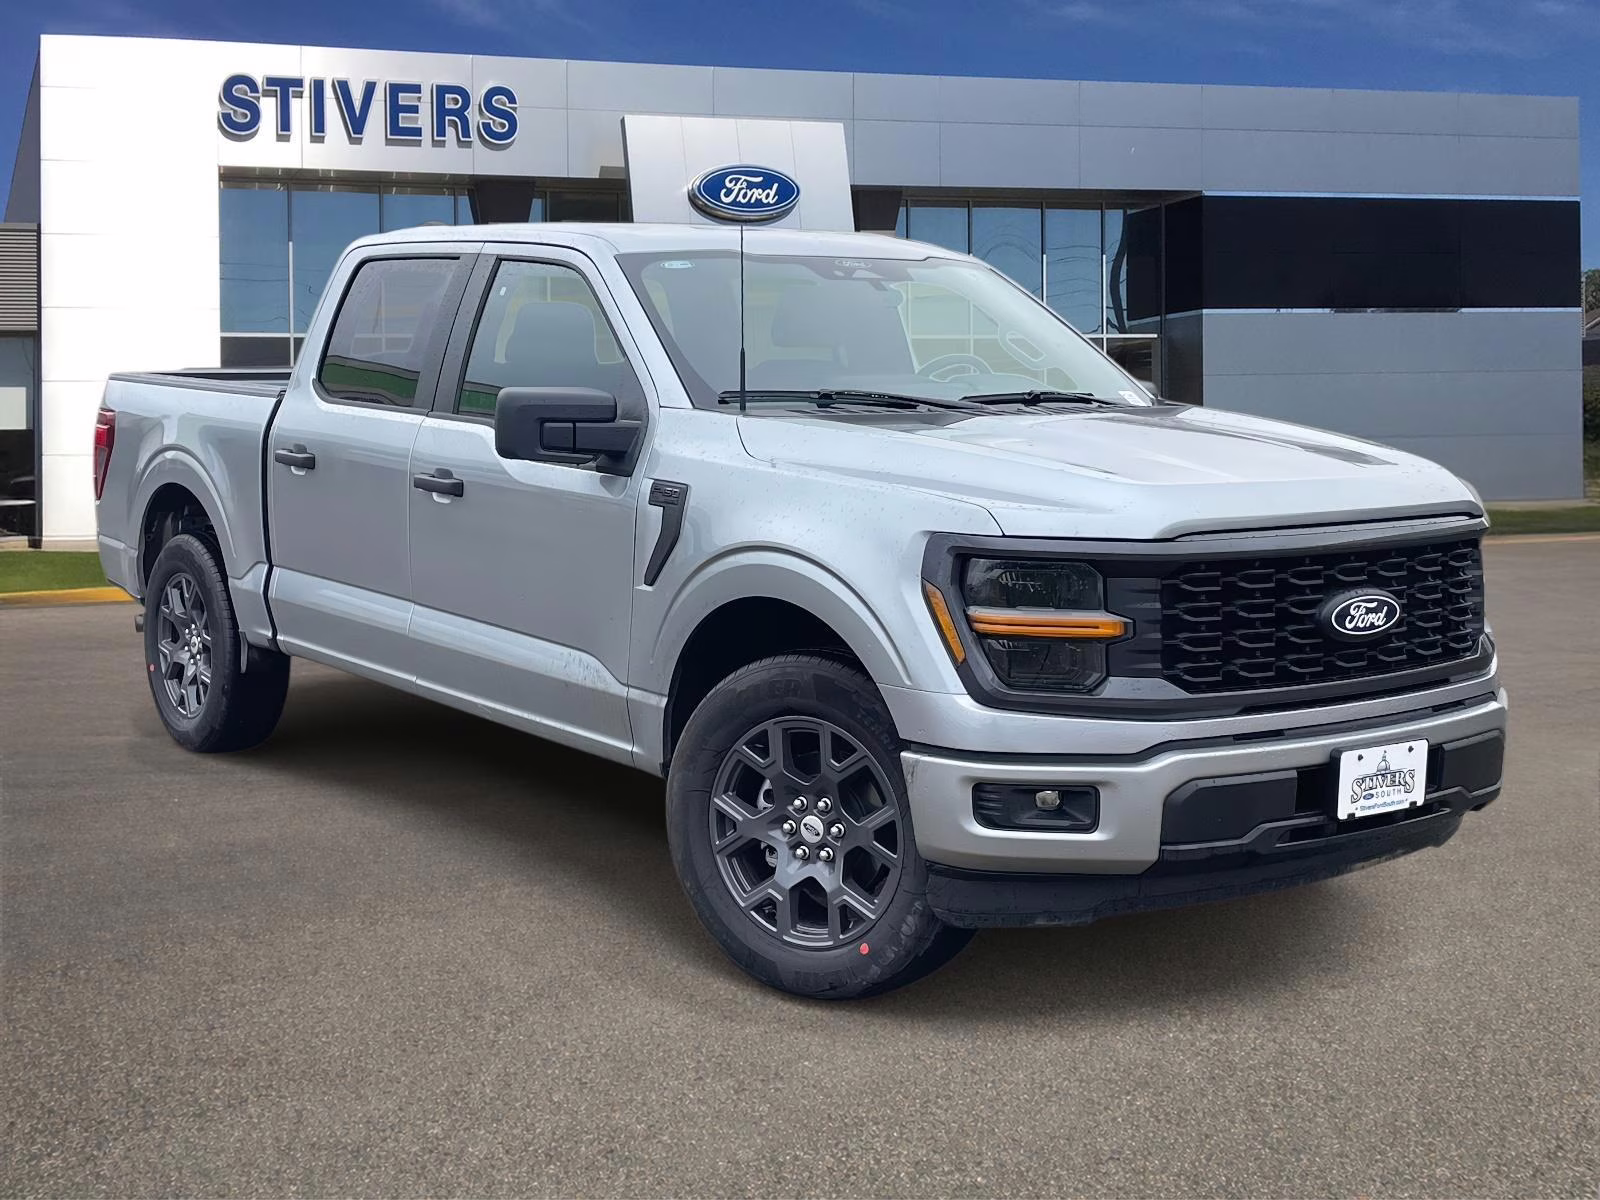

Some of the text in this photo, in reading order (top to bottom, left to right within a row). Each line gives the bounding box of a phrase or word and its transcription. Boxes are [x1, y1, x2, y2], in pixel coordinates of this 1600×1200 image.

[217, 73, 519, 147] STIVERS
[720, 174, 778, 204] Ford
[1345, 601, 1388, 629] Ford
[1351, 769, 1415, 804] STIVERS
[1375, 788, 1402, 799] SOUTH
